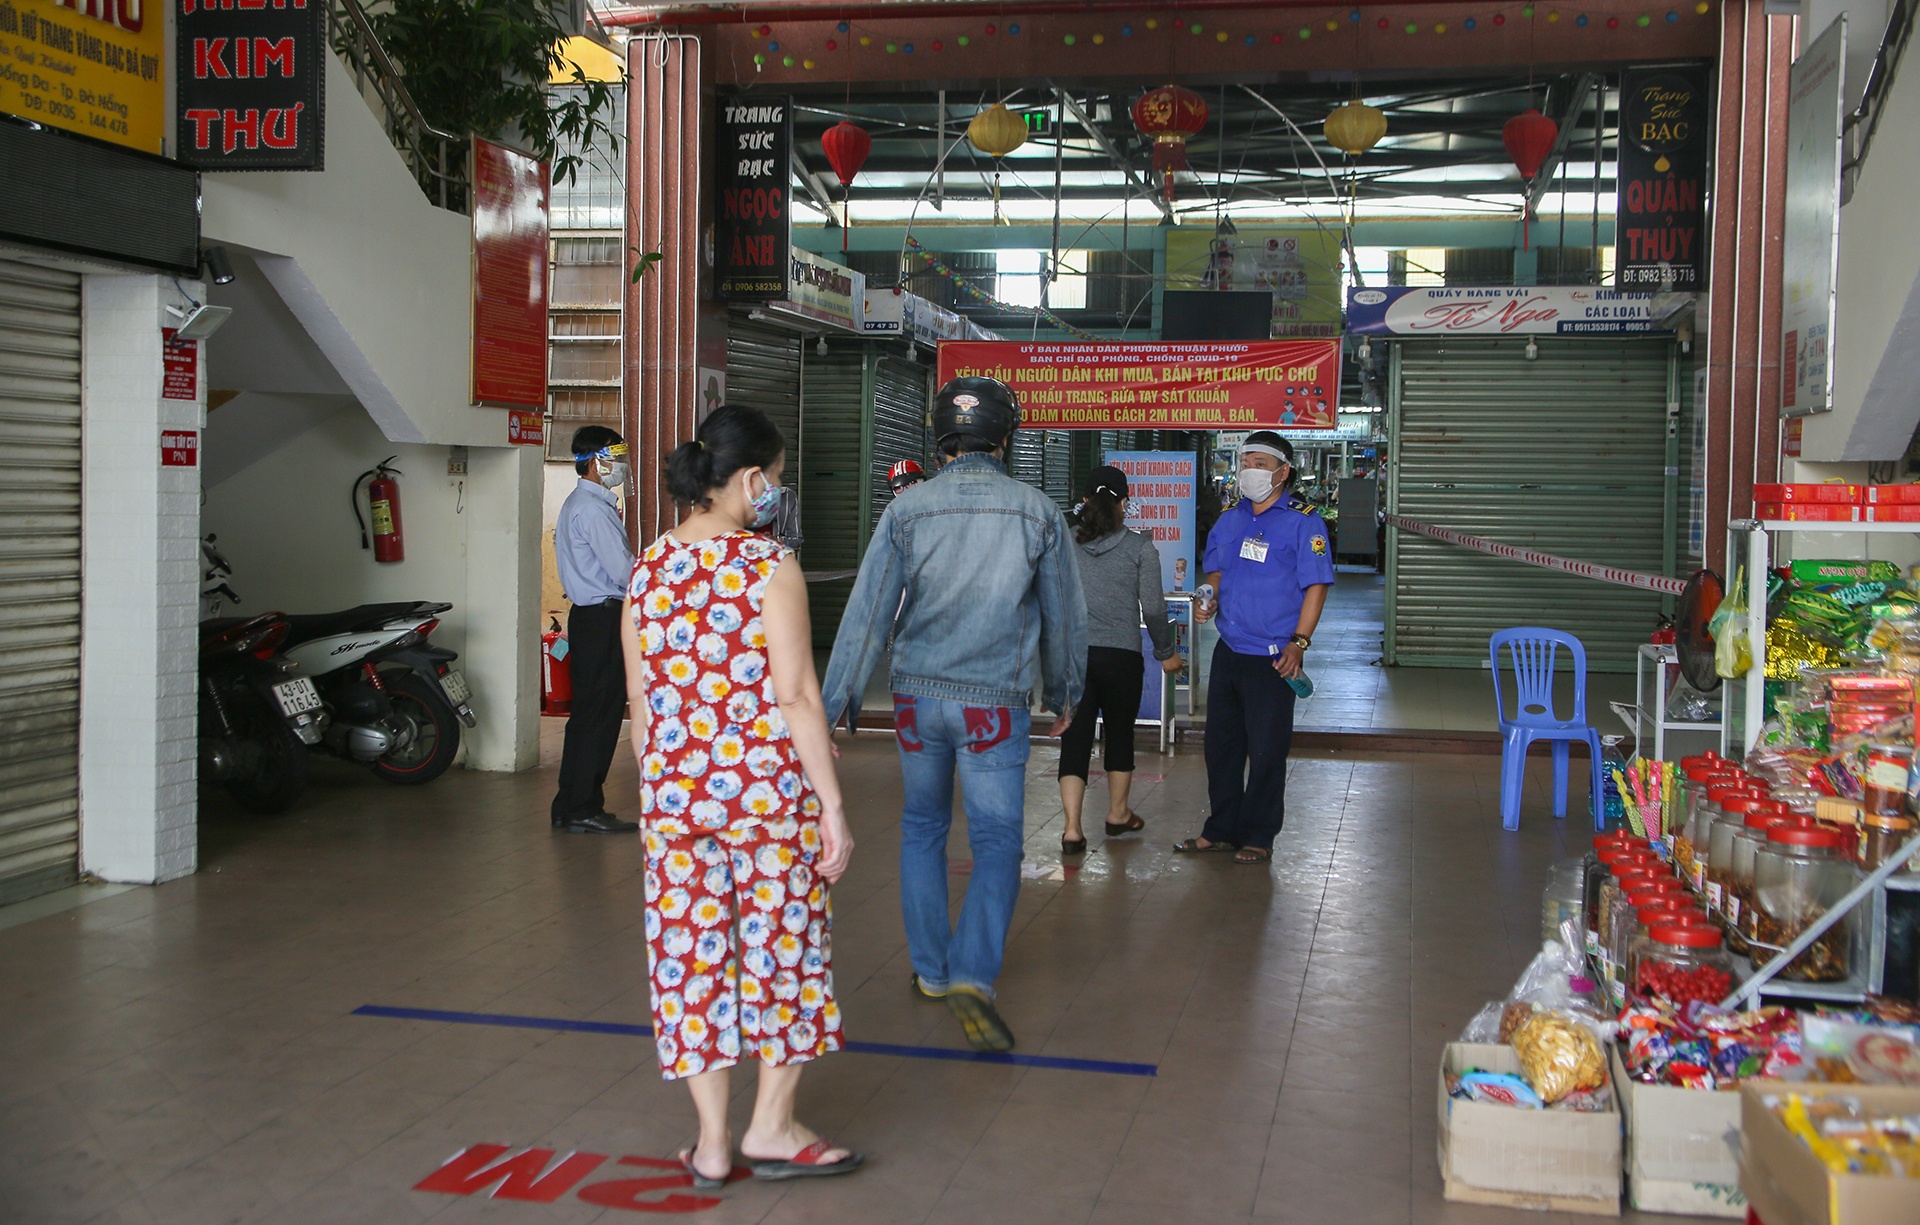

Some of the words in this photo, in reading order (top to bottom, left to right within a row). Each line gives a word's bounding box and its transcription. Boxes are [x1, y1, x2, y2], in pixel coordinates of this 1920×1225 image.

[40, 18, 74, 54] TRANG
[76, 28, 103, 64] VÀNG
[105, 42, 125, 74] BẠC
[194, 37, 295, 79] KIM
[1642, 86, 1692, 107] Trang
[89, 112, 106, 129] 144
[725, 106, 783, 124] TRANG
[185, 101, 305, 155] THƯ
[1641, 122, 1689, 144] BẠC
[739, 130, 775, 150] SỨC
[738, 159, 775, 179] BẠC
[1627, 172, 1697, 214] QUÂN
[723, 188, 782, 225] NGỌC
[728, 227, 775, 266] ÁNH
[1626, 215, 1695, 261] THỦY
[1623, 269, 1637, 283] ĐT:
[1638, 269, 1660, 282] 0982
[1680, 269, 1696, 282] 718
[735, 283, 754, 291] 0906
[1467, 288, 1501, 297] HÀNG
[1446, 296, 1560, 332] Nga
[1585, 304, 1609, 318] CÁC
[1614, 306, 1641, 319] LOẠI
[1063, 345, 1094, 353] NHÂN
[1097, 345, 1120, 353] DÂN
[1123, 344, 1168, 353] PHƯỜNG
[1171, 345, 1208, 354] THUẬN
[1211, 344, 1249, 353] PHƯỚC
[1056, 354, 1074, 363] CHỈ
[1077, 356, 1099, 364] ĐẠO
[1146, 354, 1188, 363] CHỐNG
[1192, 355, 1238, 363] COVID-19
[985, 364, 1012, 382] CẦU
[1016, 365, 1058, 382] NGƯỜI
[1062, 366, 1092, 382] DÂN
[1095, 368, 1118, 382] KHI
[1123, 367, 1158, 384] MUA,
[1162, 365, 1191, 382] BÁN
[1196, 367, 1218, 384] TẠI
[1222, 366, 1251, 382] KHU
[1256, 366, 1284, 384] VỰC
[1288, 365, 1318, 384] CHỢ
[1031, 386, 1063, 403] KHẨU
[1066, 391, 1108, 405] TRANG;
[1111, 386, 1135, 403] RỬA
[1138, 390, 1158, 403] TAY
[1162, 387, 1185, 403] SÁT
[1188, 385, 1230, 403] KHUẨN
[1031, 405, 1058, 422] ĐẢM
[1062, 405, 1110, 422] KHOẢNG
[1114, 406, 1146, 422] CÁCH
[1149, 409, 1168, 422] 2M
[1171, 409, 1191, 422] KHI
[1195, 409, 1226, 423] MUA,
[1229, 406, 1258, 422] BÁN.
[173, 451, 186, 464] PNJ
[1122, 457, 1135, 476] CẦU
[1136, 458, 1148, 476] GIỮ
[1148, 457, 1174, 476] KHOẢNG
[1175, 459, 1192, 476] CÁCH
[1137, 481, 1154, 498] HÀNG
[1173, 481, 1191, 498] CÁCH
[1159, 505, 1166, 522] VỊ
[1167, 503, 1178, 519] TRÍ
[1152, 525, 1167, 541] TRÊN
[1168, 525, 1181, 541] SÀN
[331, 641, 359, 656] SH
[280, 679, 309, 698] 43-D1
[283, 693, 320, 714] 116.45
